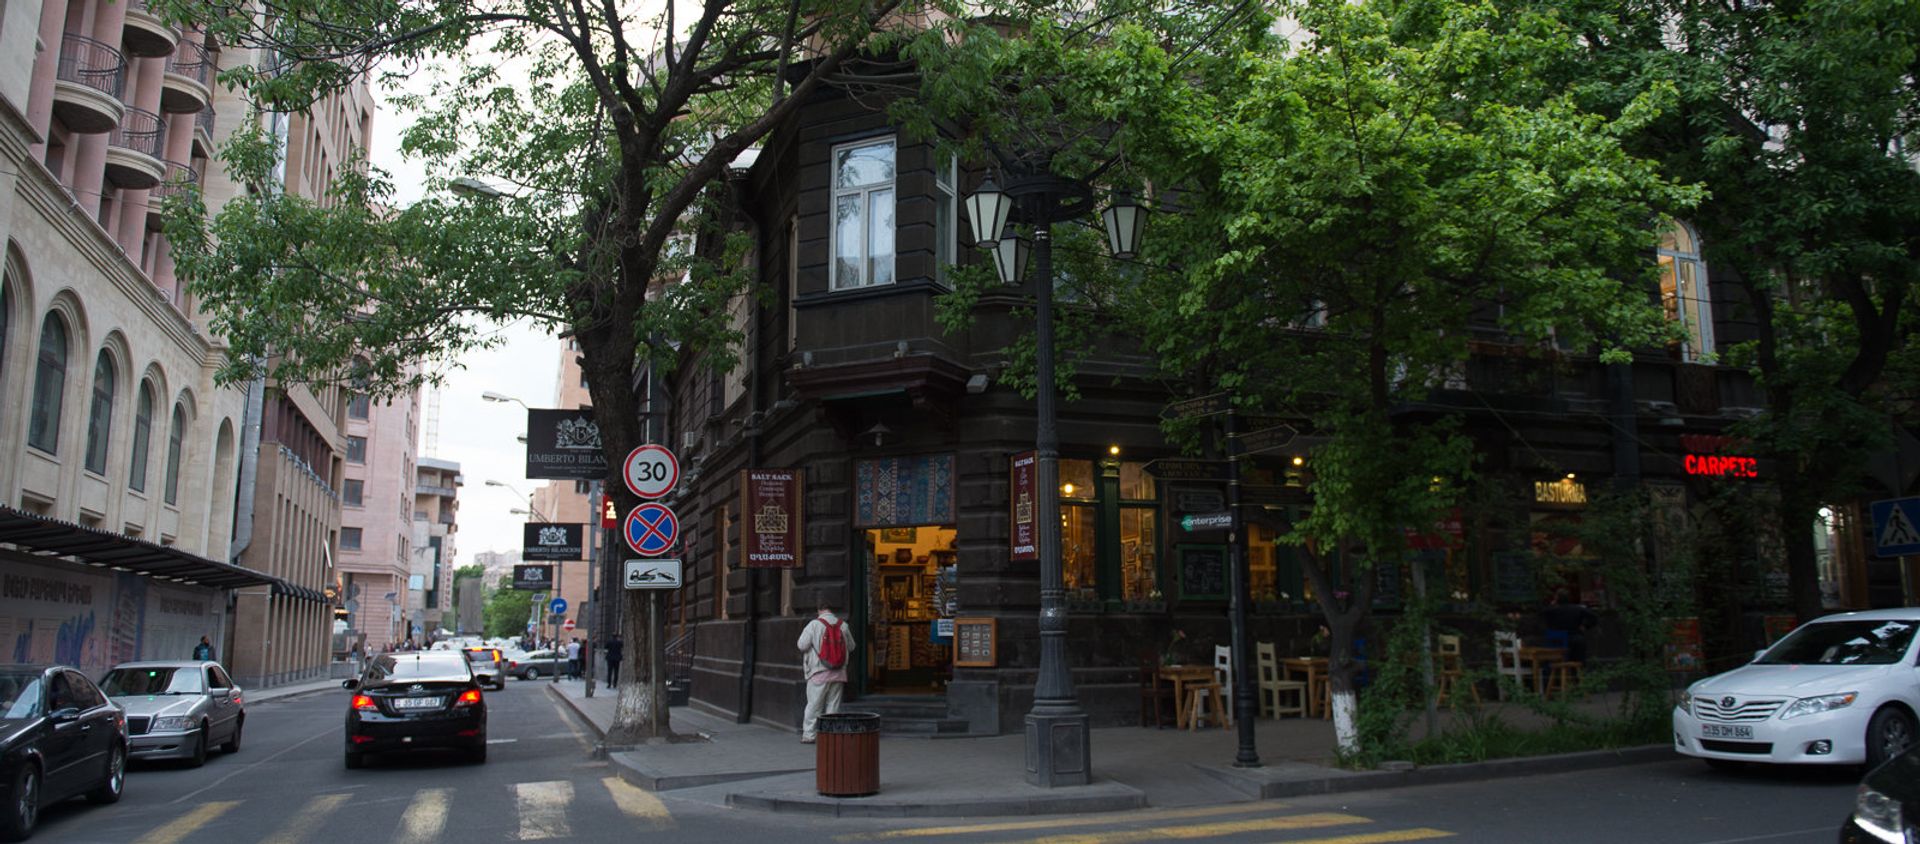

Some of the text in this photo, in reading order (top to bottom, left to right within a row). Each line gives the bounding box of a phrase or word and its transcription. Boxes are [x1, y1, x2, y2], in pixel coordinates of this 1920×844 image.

[528, 453, 575, 464] UMBERTO
[637, 461, 667, 482] 30
[1535, 480, 1587, 503] BASTURMA
[1187, 514, 1232, 525] enterprise
